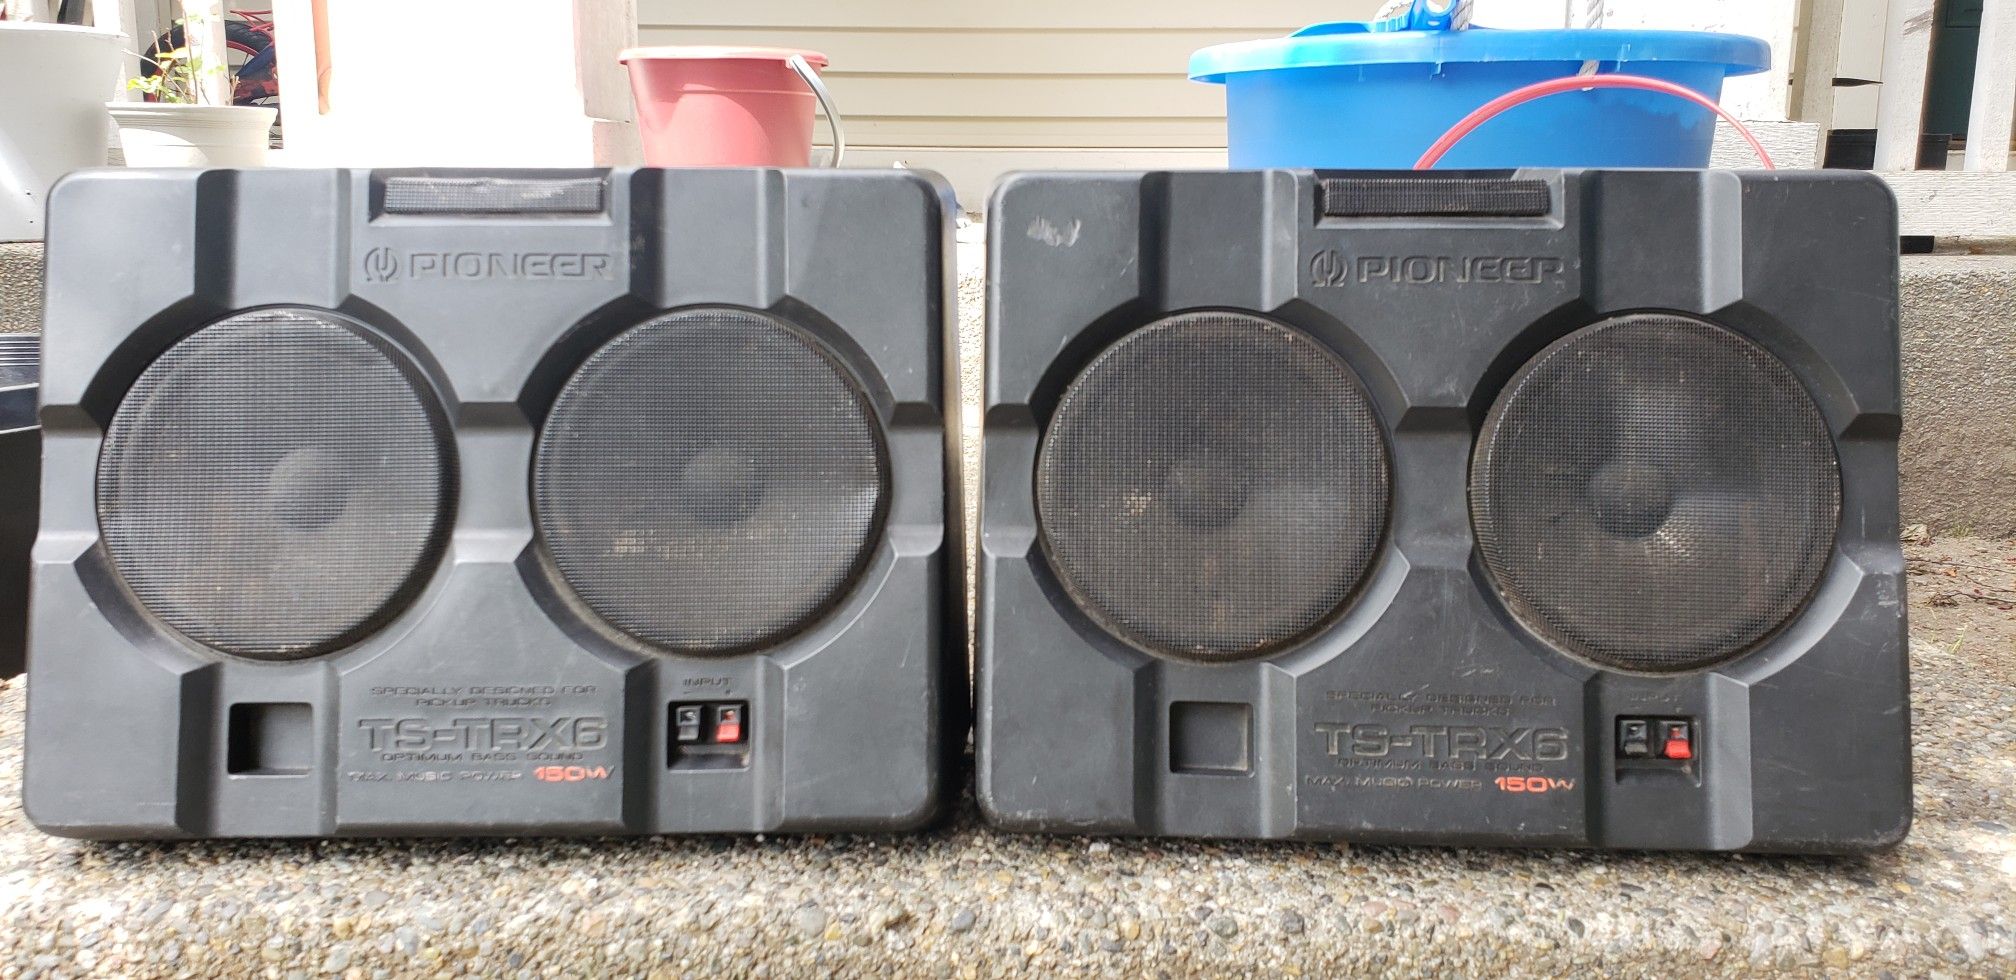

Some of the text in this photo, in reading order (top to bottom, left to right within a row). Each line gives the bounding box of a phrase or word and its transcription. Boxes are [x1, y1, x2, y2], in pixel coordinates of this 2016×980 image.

[409, 252, 614, 281] PIONEER
[1356, 255, 1567, 285] PIONEER
[371, 685, 598, 697] SPECIALLY DESIGNED FOR
[683, 677, 732, 687] INPUT
[484, 697, 552, 706] TRUCKS
[357, 716, 609, 752] TS-TRX6
[1313, 721, 1570, 761] TS-TRX6
[381, 751, 584, 762] OPTIMUM BASS SOUND
[533, 764, 616, 783] 150W
[1417, 777, 1483, 790] POWER
[1493, 775, 1576, 793] 150W
